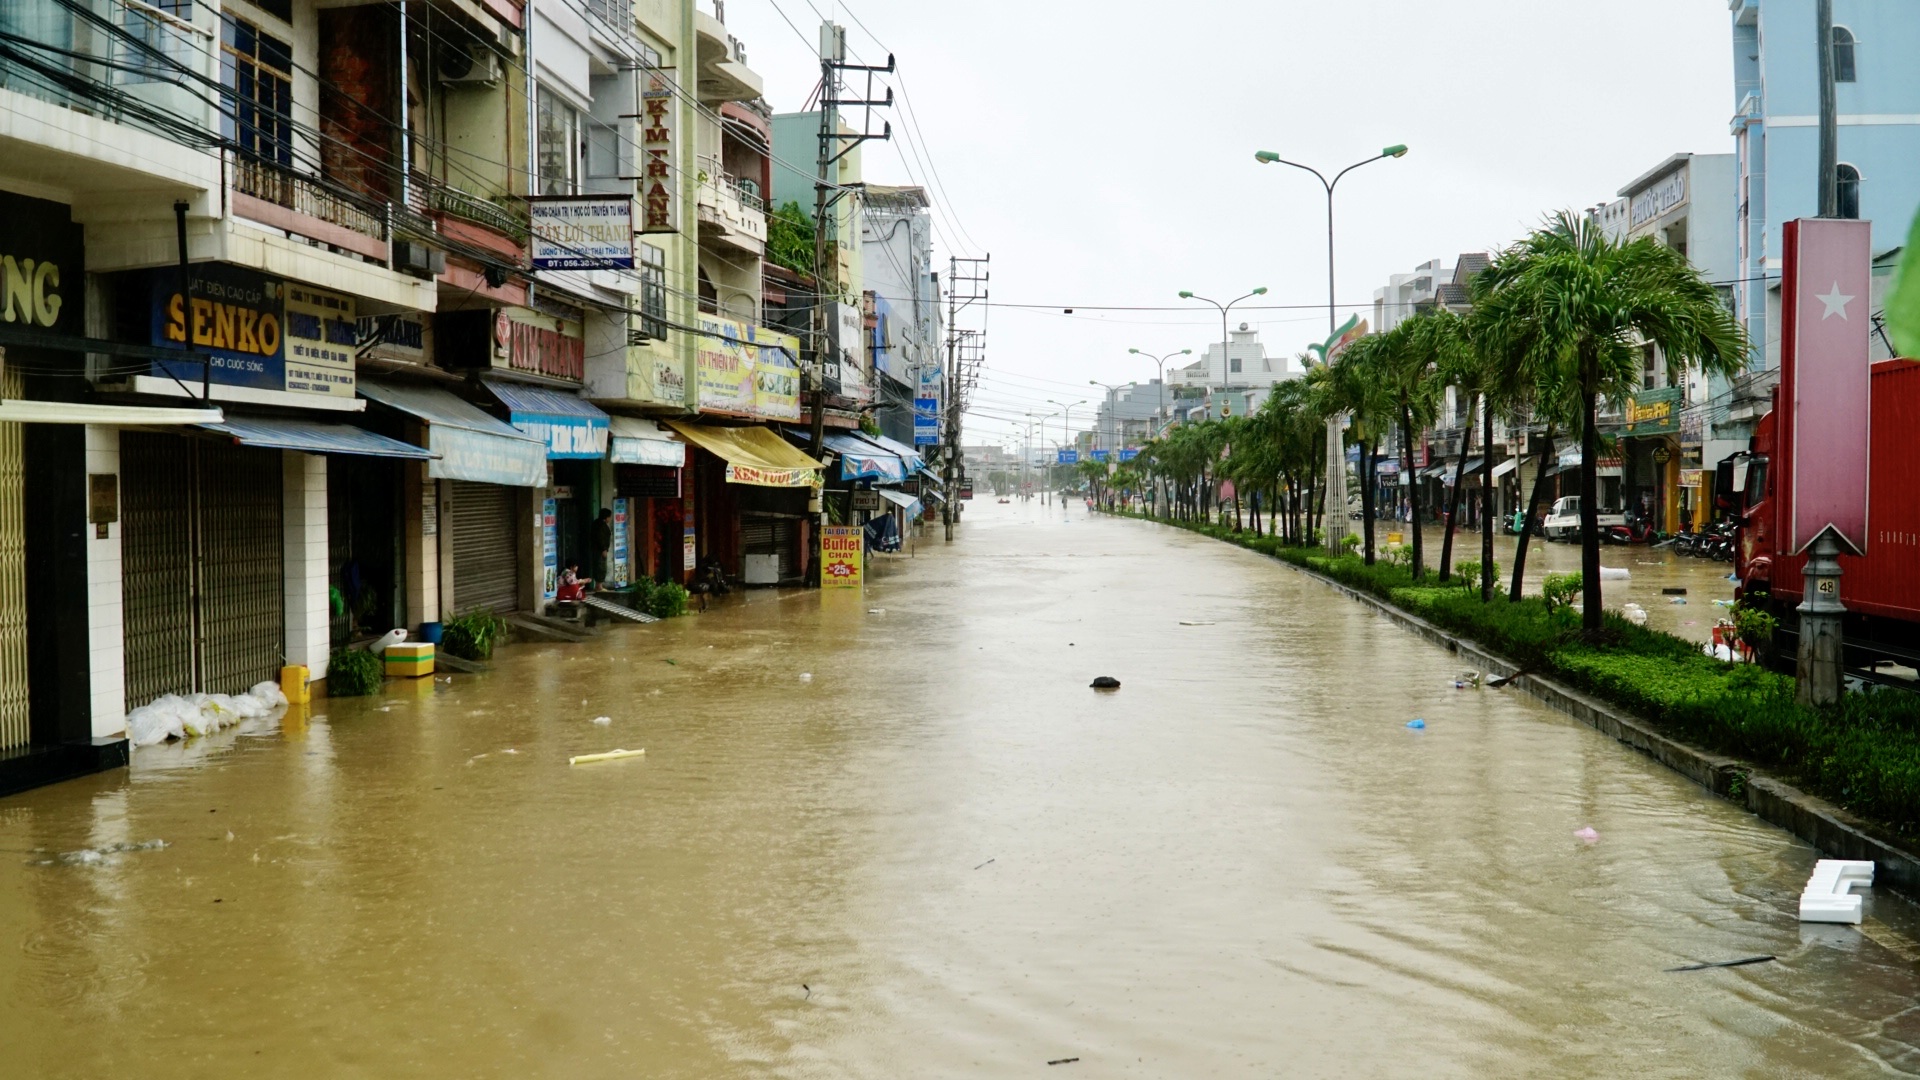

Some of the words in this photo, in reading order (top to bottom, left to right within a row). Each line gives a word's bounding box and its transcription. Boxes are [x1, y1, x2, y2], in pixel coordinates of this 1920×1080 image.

[646, 99, 669, 142] KIM
[537, 222, 561, 242] TÂN
[565, 223, 584, 245] LỢI
[588, 220, 632, 242] THÀNH
[228, 286, 244, 301] CAO
[167, 293, 280, 356] SENKO
[511, 321, 540, 369] KIM
[210, 356, 224, 368] CHO
[226, 358, 245, 371] CUỘC
[246, 360, 264, 373] SỐNG
[733, 466, 760, 482] KEM
[823, 538, 860, 551] Buffet
[1819, 581, 1834, 593] 48
